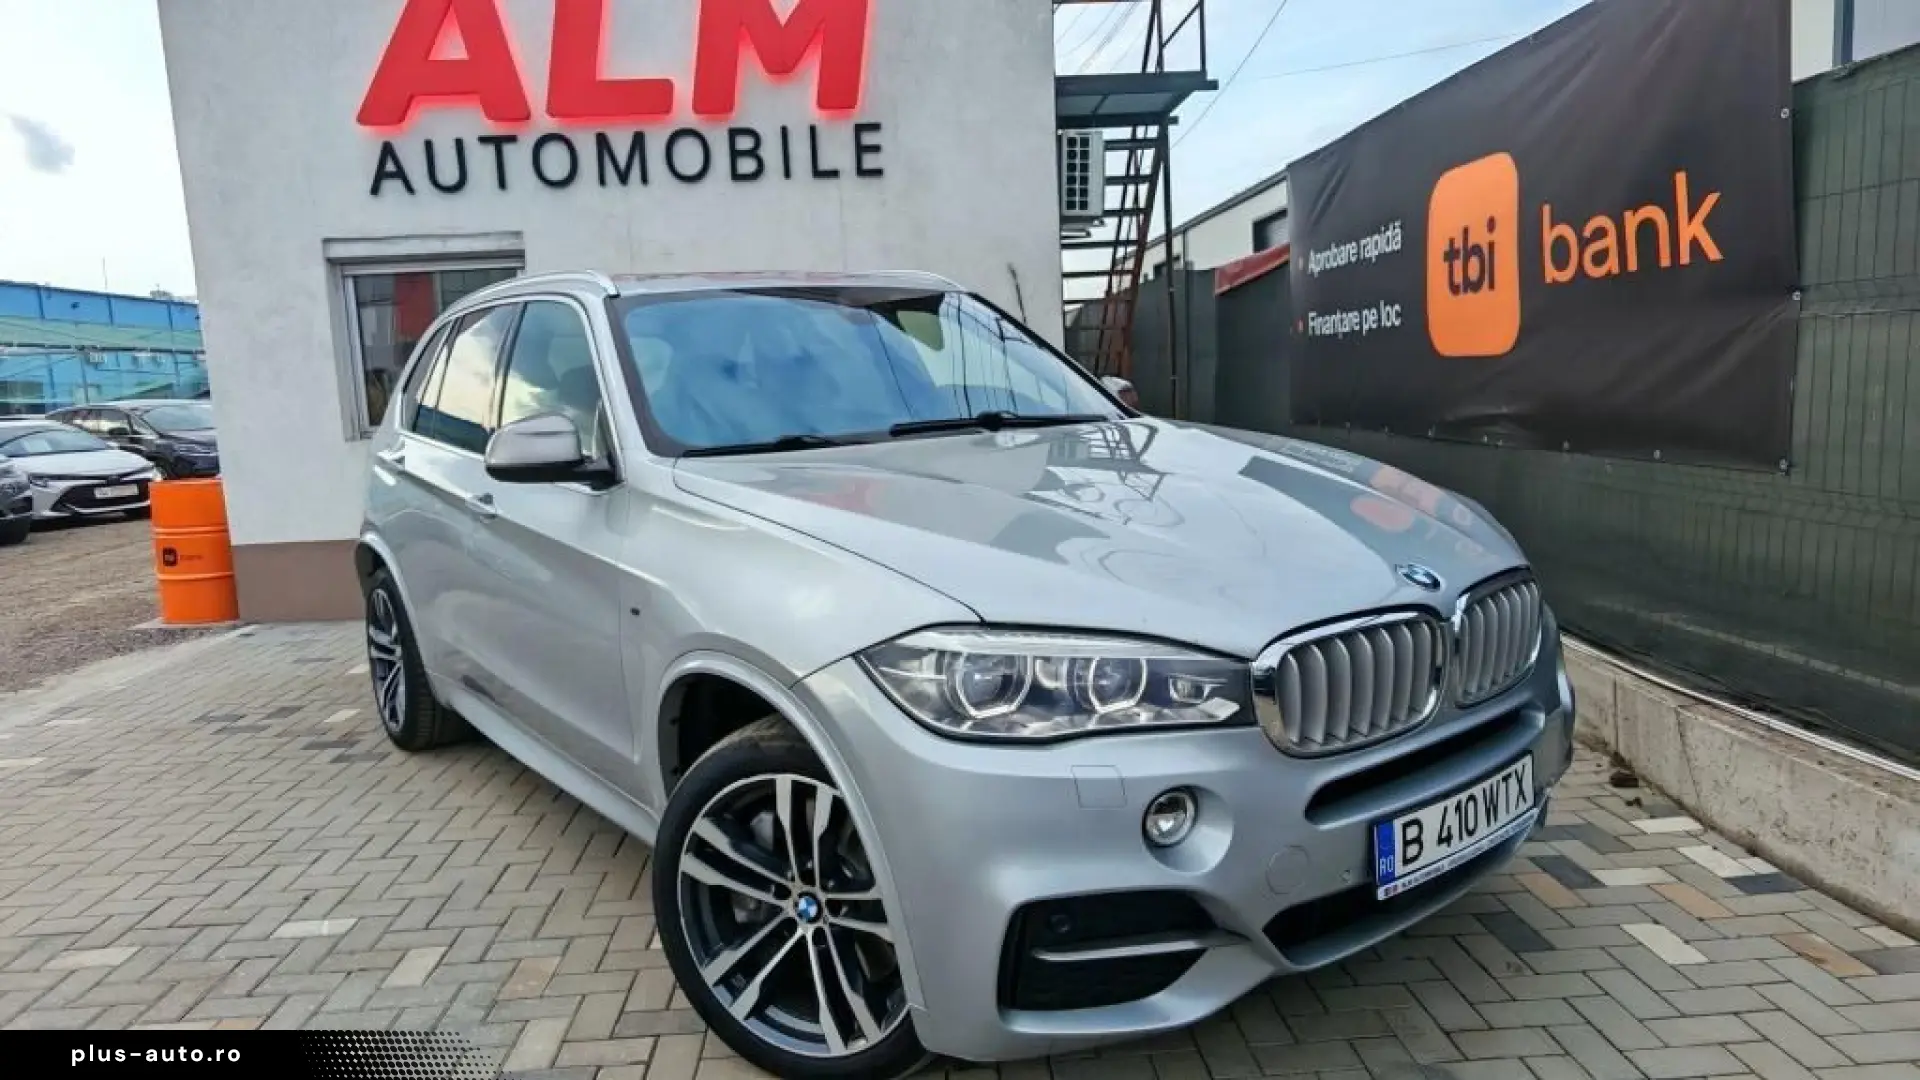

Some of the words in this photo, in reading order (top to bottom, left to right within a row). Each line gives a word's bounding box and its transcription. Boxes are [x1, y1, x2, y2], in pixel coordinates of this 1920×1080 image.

[357, 0, 869, 126] ALM
[370, 122, 884, 196] AUTOMOBILE
[1308, 242, 1358, 278] Aprobare
[1360, 219, 1402, 264] rapidă
[1443, 216, 1496, 296] tbi
[1541, 170, 1724, 284] bank
[1362, 307, 1378, 336] pe
[1380, 300, 1402, 328] loc
[1402, 817, 1424, 867] B
[1437, 793, 1479, 848] 410
[1483, 764, 1527, 828] WTX
[1379, 856, 1394, 877] RO
